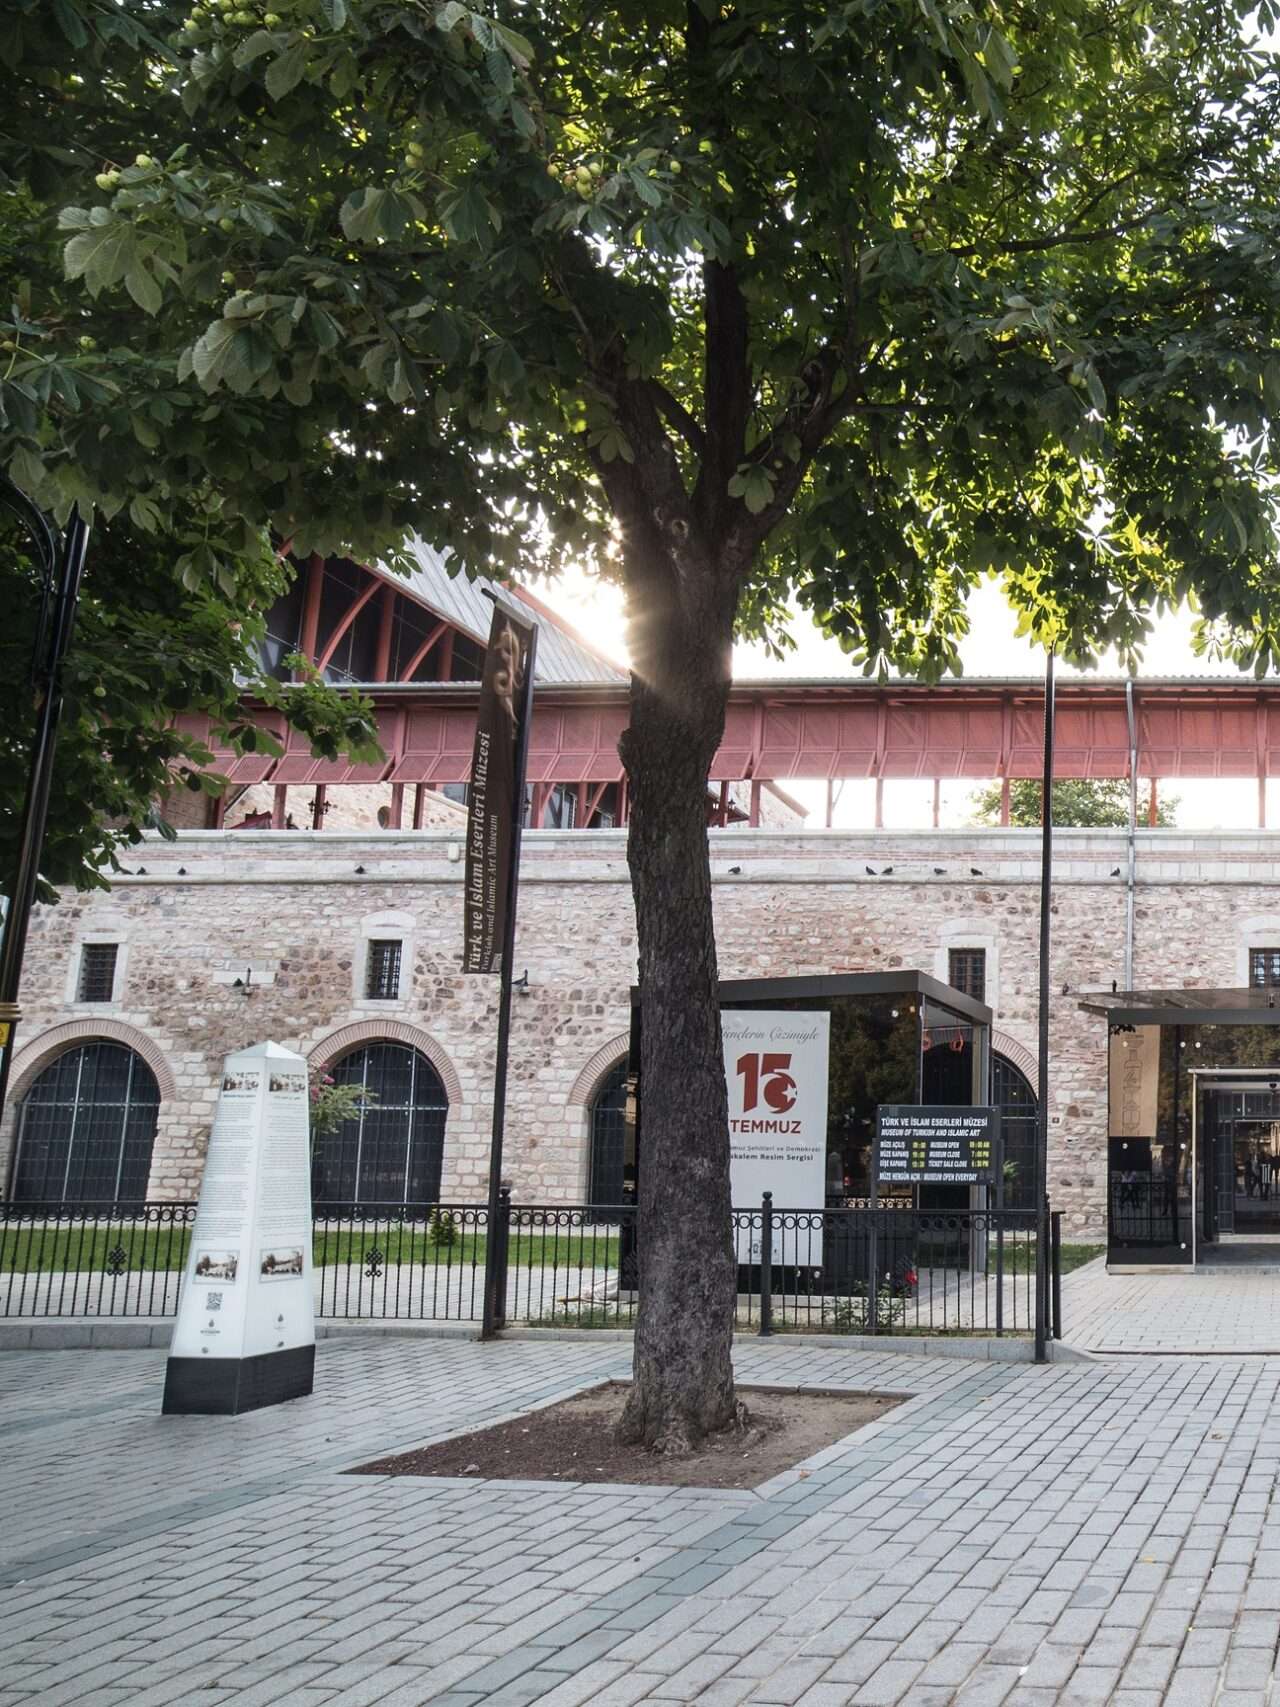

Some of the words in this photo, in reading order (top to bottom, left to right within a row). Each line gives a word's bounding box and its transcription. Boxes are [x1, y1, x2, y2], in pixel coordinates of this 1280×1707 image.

[473, 731, 491, 791] Müzesi
[470, 792, 486, 859] Eserleri
[487, 815, 499, 858] Museum
[467, 863, 484, 907] İslam
[487, 859, 497, 876] Art
[486, 876, 497, 913] Islamic
[472, 911, 484, 930] ve
[486, 914, 495, 934] and
[468, 936, 482, 971] Türk
[481, 935, 493, 970] Turkish
[736, 1053, 797, 1115] 15
[730, 1119, 802, 1134] TEMMUZ
[881, 1116, 899, 1126] TÜRK
[900, 1117, 909, 1126] VE
[910, 1116, 930, 1126] İSLAM
[931, 1116, 962, 1127] ESERLERİ
[963, 1116, 988, 1127] MÜZESİ
[881, 1129, 904, 1137] MUSEUM
[904, 1129, 912, 1137] OF
[912, 1129, 935, 1137] TURKISH
[936, 1129, 947, 1137] AND
[947, 1129, 969, 1137] ISLAMIC
[969, 1129, 981, 1137] ART
[786, 1154, 814, 1162] Sergisi
